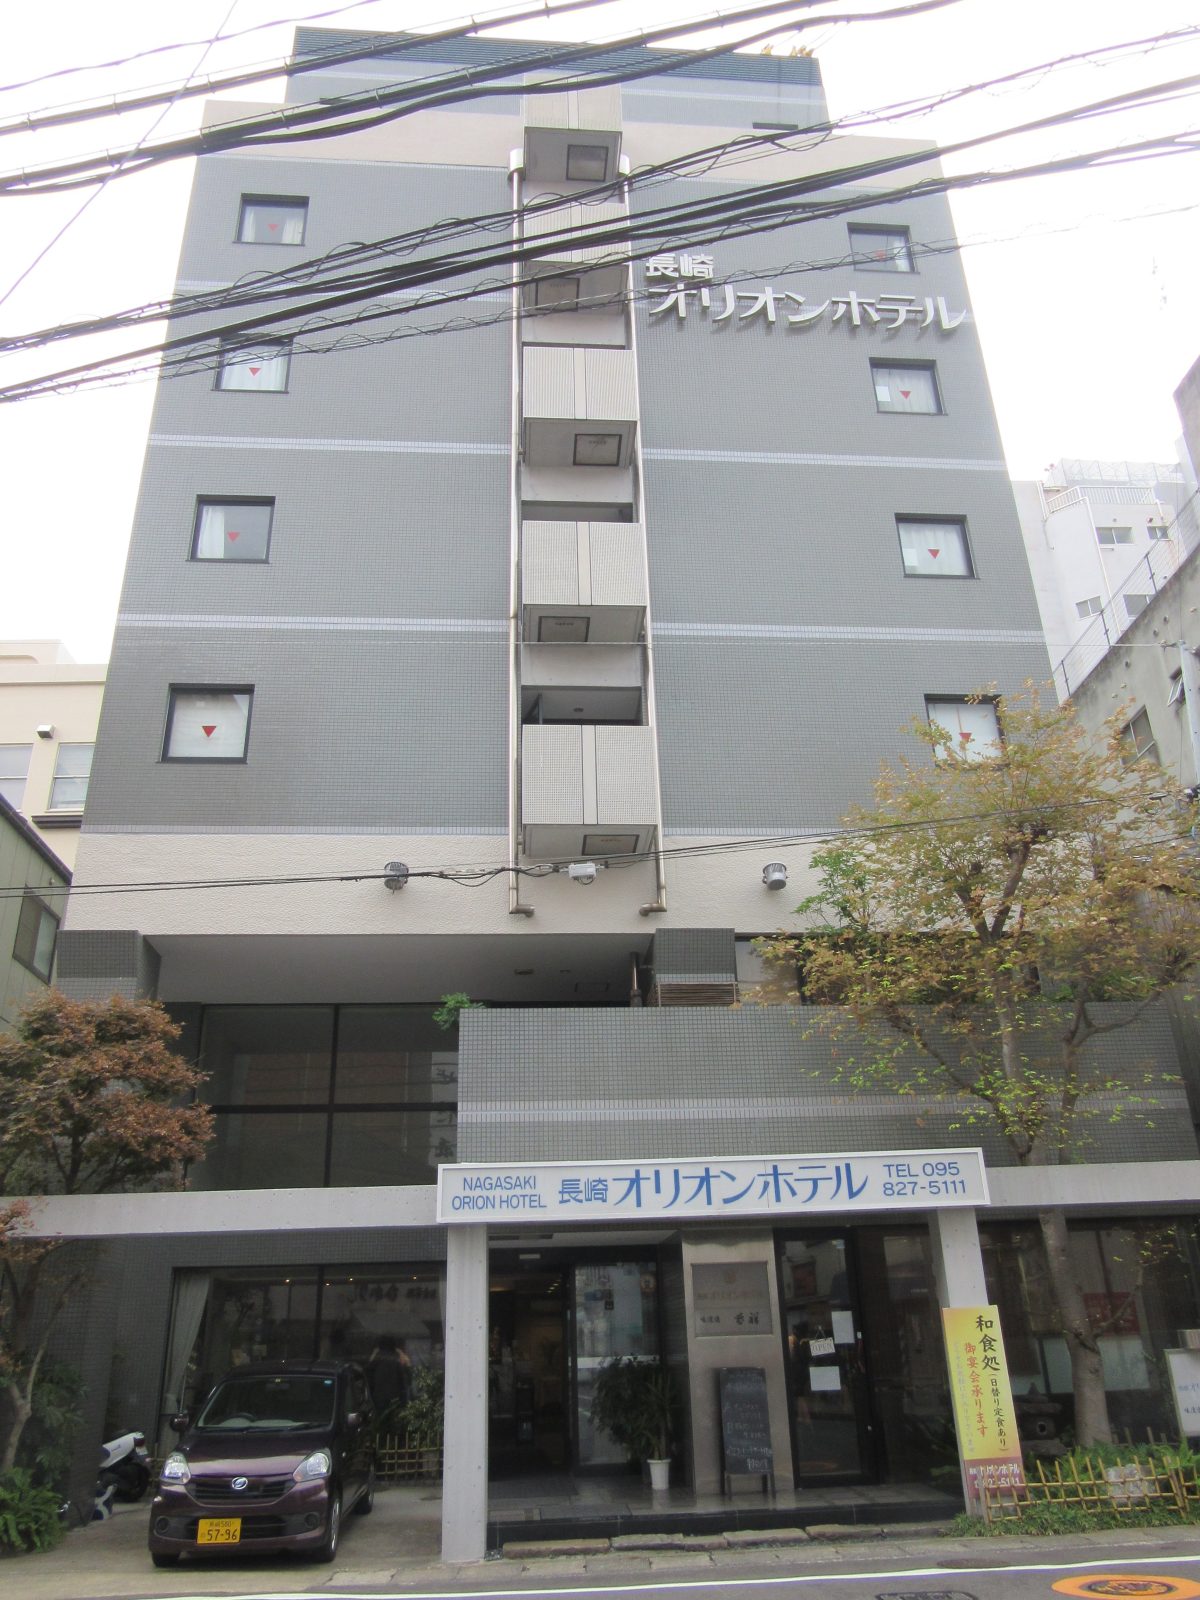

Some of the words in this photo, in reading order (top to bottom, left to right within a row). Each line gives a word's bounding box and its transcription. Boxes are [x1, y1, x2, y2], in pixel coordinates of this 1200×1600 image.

[646, 253, 714, 279] 長崎
[648, 283, 967, 330] オリオンホテル
[883, 1163, 918, 1178] TEL
[922, 1161, 960, 1176] 095
[463, 1175, 537, 1191] NAGASAKI
[883, 1179, 967, 1197] 827-5111
[452, 1195, 497, 1211] ORION
[499, 1194, 547, 1209] HOTEL
[964, 1342, 987, 1438] 御宴会承ります
[207, 1528, 238, 1541] 57-96
